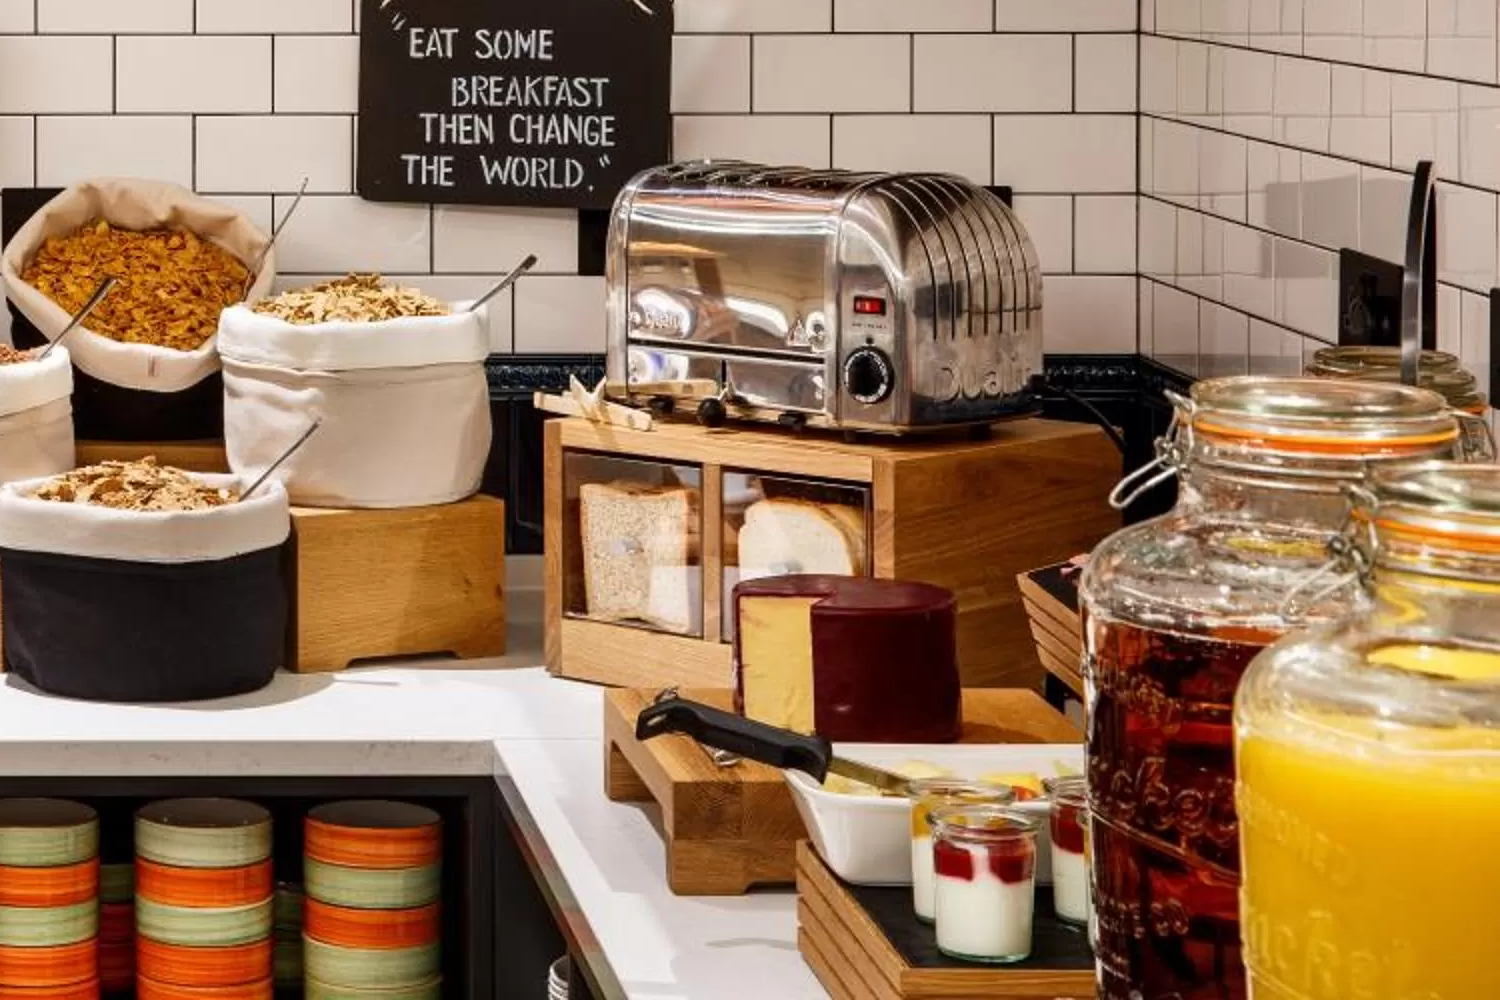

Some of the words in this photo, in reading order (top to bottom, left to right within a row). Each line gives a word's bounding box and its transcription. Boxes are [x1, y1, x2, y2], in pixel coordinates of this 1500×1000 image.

[475, 28, 554, 60] SOME
[451, 75, 609, 108] BREAKFAST
[419, 112, 495, 145] THEN
[509, 113, 616, 147] CHANGE
[401, 154, 455, 187] THE
